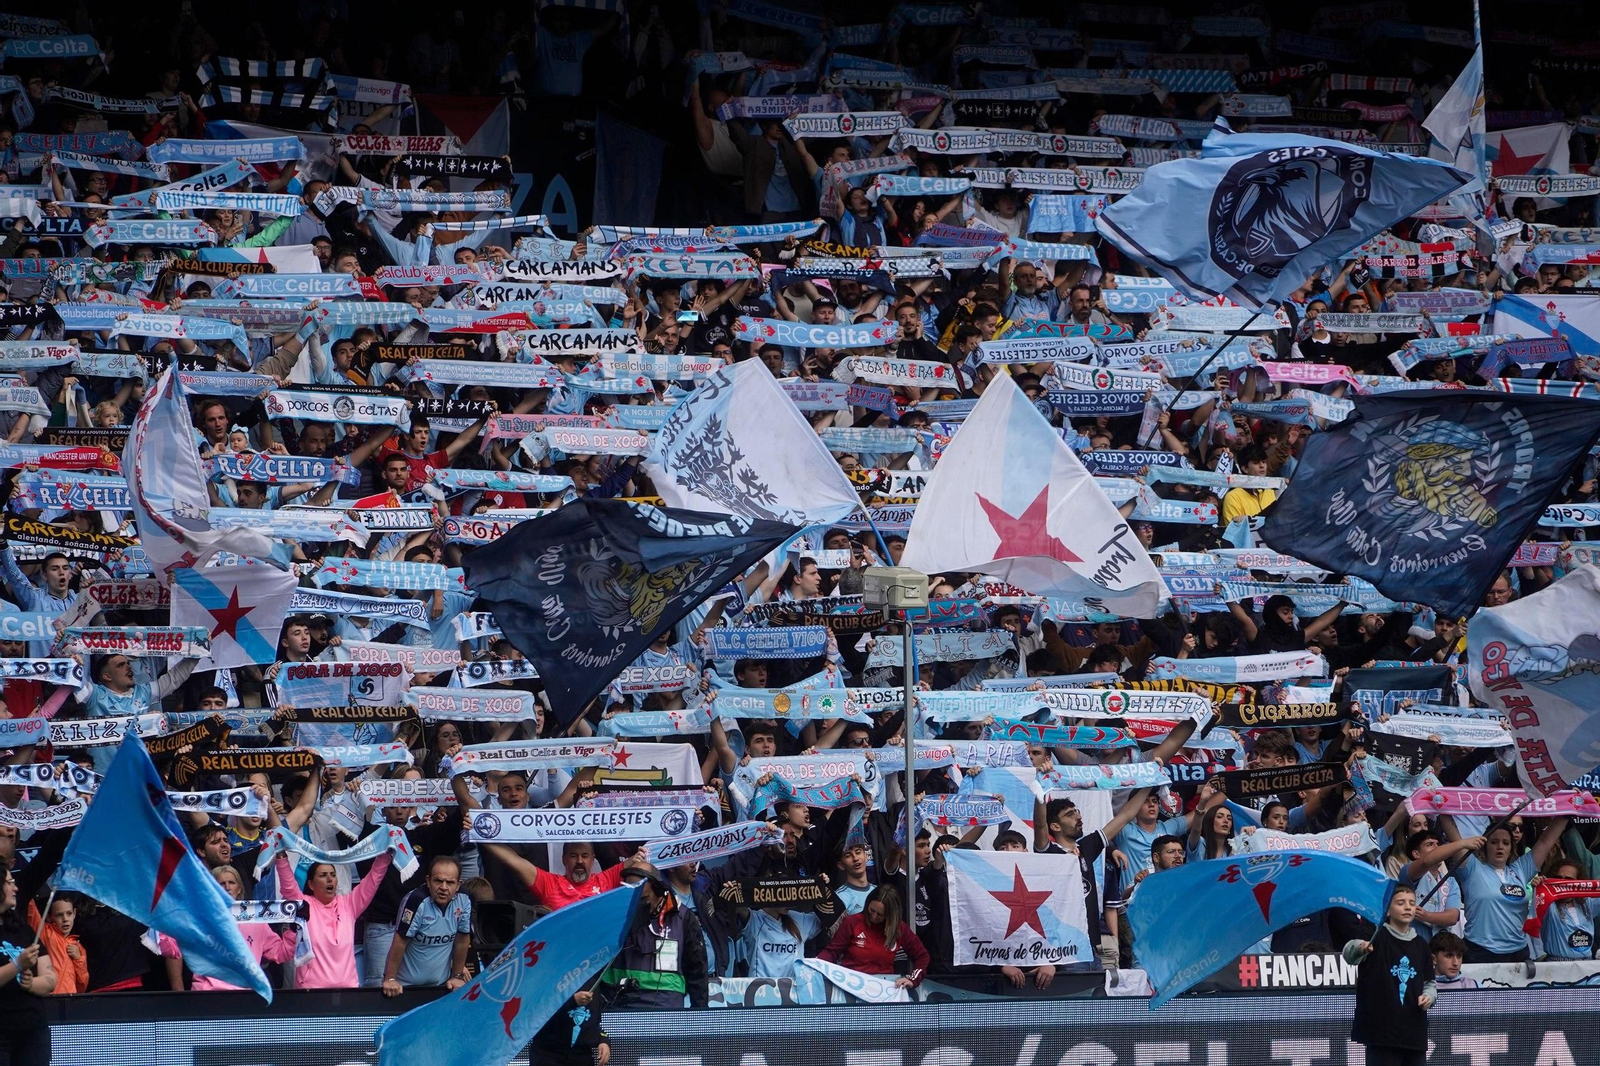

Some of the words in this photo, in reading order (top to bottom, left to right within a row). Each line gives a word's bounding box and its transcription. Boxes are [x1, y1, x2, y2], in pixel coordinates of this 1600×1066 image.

[14, 41, 88, 55] RCCelta
[894, 176, 968, 192] RCCelta
[117, 223, 190, 239] RCCelta
[175, 260, 205, 271] REAL
[206, 262, 235, 273] CLUB
[1418, 253, 1459, 264] CELESTE
[259, 278, 331, 293] RCCelta
[562, 285, 619, 299] RCCelta
[1321, 314, 1370, 327] SEMPRE
[1378, 315, 1417, 329] CELTA
[778, 324, 870, 344] RCCelta
[47, 346, 67, 357] Vigo
[379, 347, 402, 358] REAL
[404, 348, 434, 359] CLUB
[435, 348, 466, 359] CELTA
[989, 350, 1031, 359] CELESTES
[1034, 346, 1088, 356] CORVOS
[287, 401, 329, 412] PORCOS
[358, 404, 398, 417] CELTAS
[594, 435, 610, 446] DE
[614, 434, 647, 448] XOGO
[219, 458, 240, 473] R.C.
[265, 459, 325, 476] CELTA
[455, 470, 490, 480] IAGO
[517, 473, 563, 483] ASPAS
[40, 487, 66, 502] R.C.
[1171, 578, 1215, 593] CELT
[2, 614, 57, 638] Celt
[717, 634, 743, 649] R.C.
[746, 633, 789, 648] CELTA
[793, 632, 825, 646] VIGO
[397, 650, 416, 664] DE
[421, 650, 460, 664] XOGO
[288, 664, 331, 680] FÓRA
[334, 664, 356, 680] DE
[360, 664, 401, 680] XOGO
[645, 665, 695, 683] XOGO
[1182, 664, 1221, 674] RCCelta
[419, 693, 454, 710] FÓRA
[462, 698, 478, 711] DE
[485, 698, 522, 713] XOGO
[717, 698, 765, 709] RCCelta
[1046, 695, 1100, 712] OVIDA
[315, 708, 344, 718] REAL
[346, 707, 373, 717] CLUB
[376, 706, 408, 716] CELTA
[51, 719, 143, 742] ALIZA
[167, 733, 188, 749] CLUB
[189, 724, 211, 744] CELTA
[480, 749, 502, 760] Real
[505, 747, 528, 758] Club
[530, 747, 557, 758] Celta
[560, 746, 571, 756] de
[575, 746, 594, 757] Vigo
[968, 742, 977, 766] A
[202, 756, 238, 770] REAL
[240, 755, 273, 769] CLUB
[276, 753, 314, 768] CELTA
[798, 763, 815, 779] DE
[820, 761, 855, 777] XOGO
[1065, 766, 1100, 781] IAGO
[1113, 763, 1155, 778] ASPAS
[360, 779, 398, 796] ORA
[401, 779, 425, 795] DE
[1241, 780, 1268, 796] REAL
[1271, 777, 1300, 795] CLUB
[1302, 769, 1334, 790] CELTA
[1458, 792, 1557, 812] RCCelta
[511, 814, 575, 827] CORVOS
[582, 811, 652, 825] CELESTES
[1324, 831, 1361, 852] XOGO
[753, 887, 775, 901] REAL
[777, 886, 797, 901] CLUB
[798, 885, 822, 900] CELTA
[969, 937, 1011, 961] Tropas
[1013, 942, 1028, 959] de
[1030, 939, 1078, 963] Breogán
